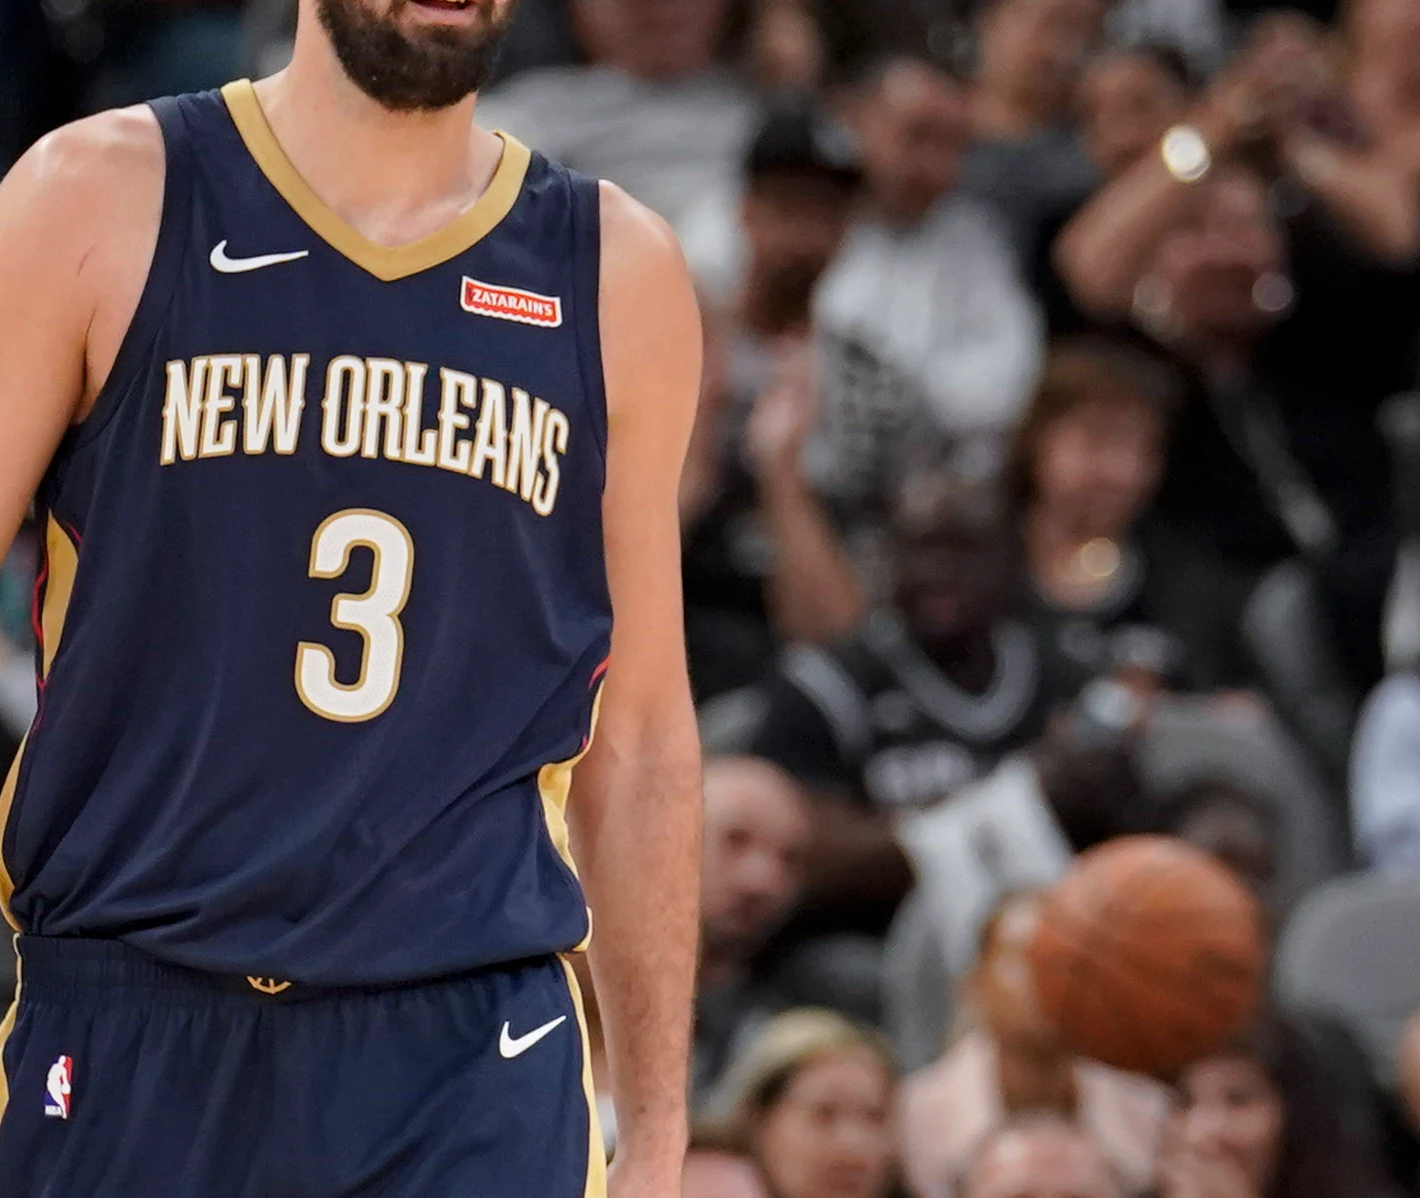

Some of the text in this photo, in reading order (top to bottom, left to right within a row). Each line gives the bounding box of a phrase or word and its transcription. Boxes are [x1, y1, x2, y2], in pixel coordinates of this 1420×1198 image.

[160, 352, 570, 517] NEW ORLEANS
[293, 507, 415, 723] 3
